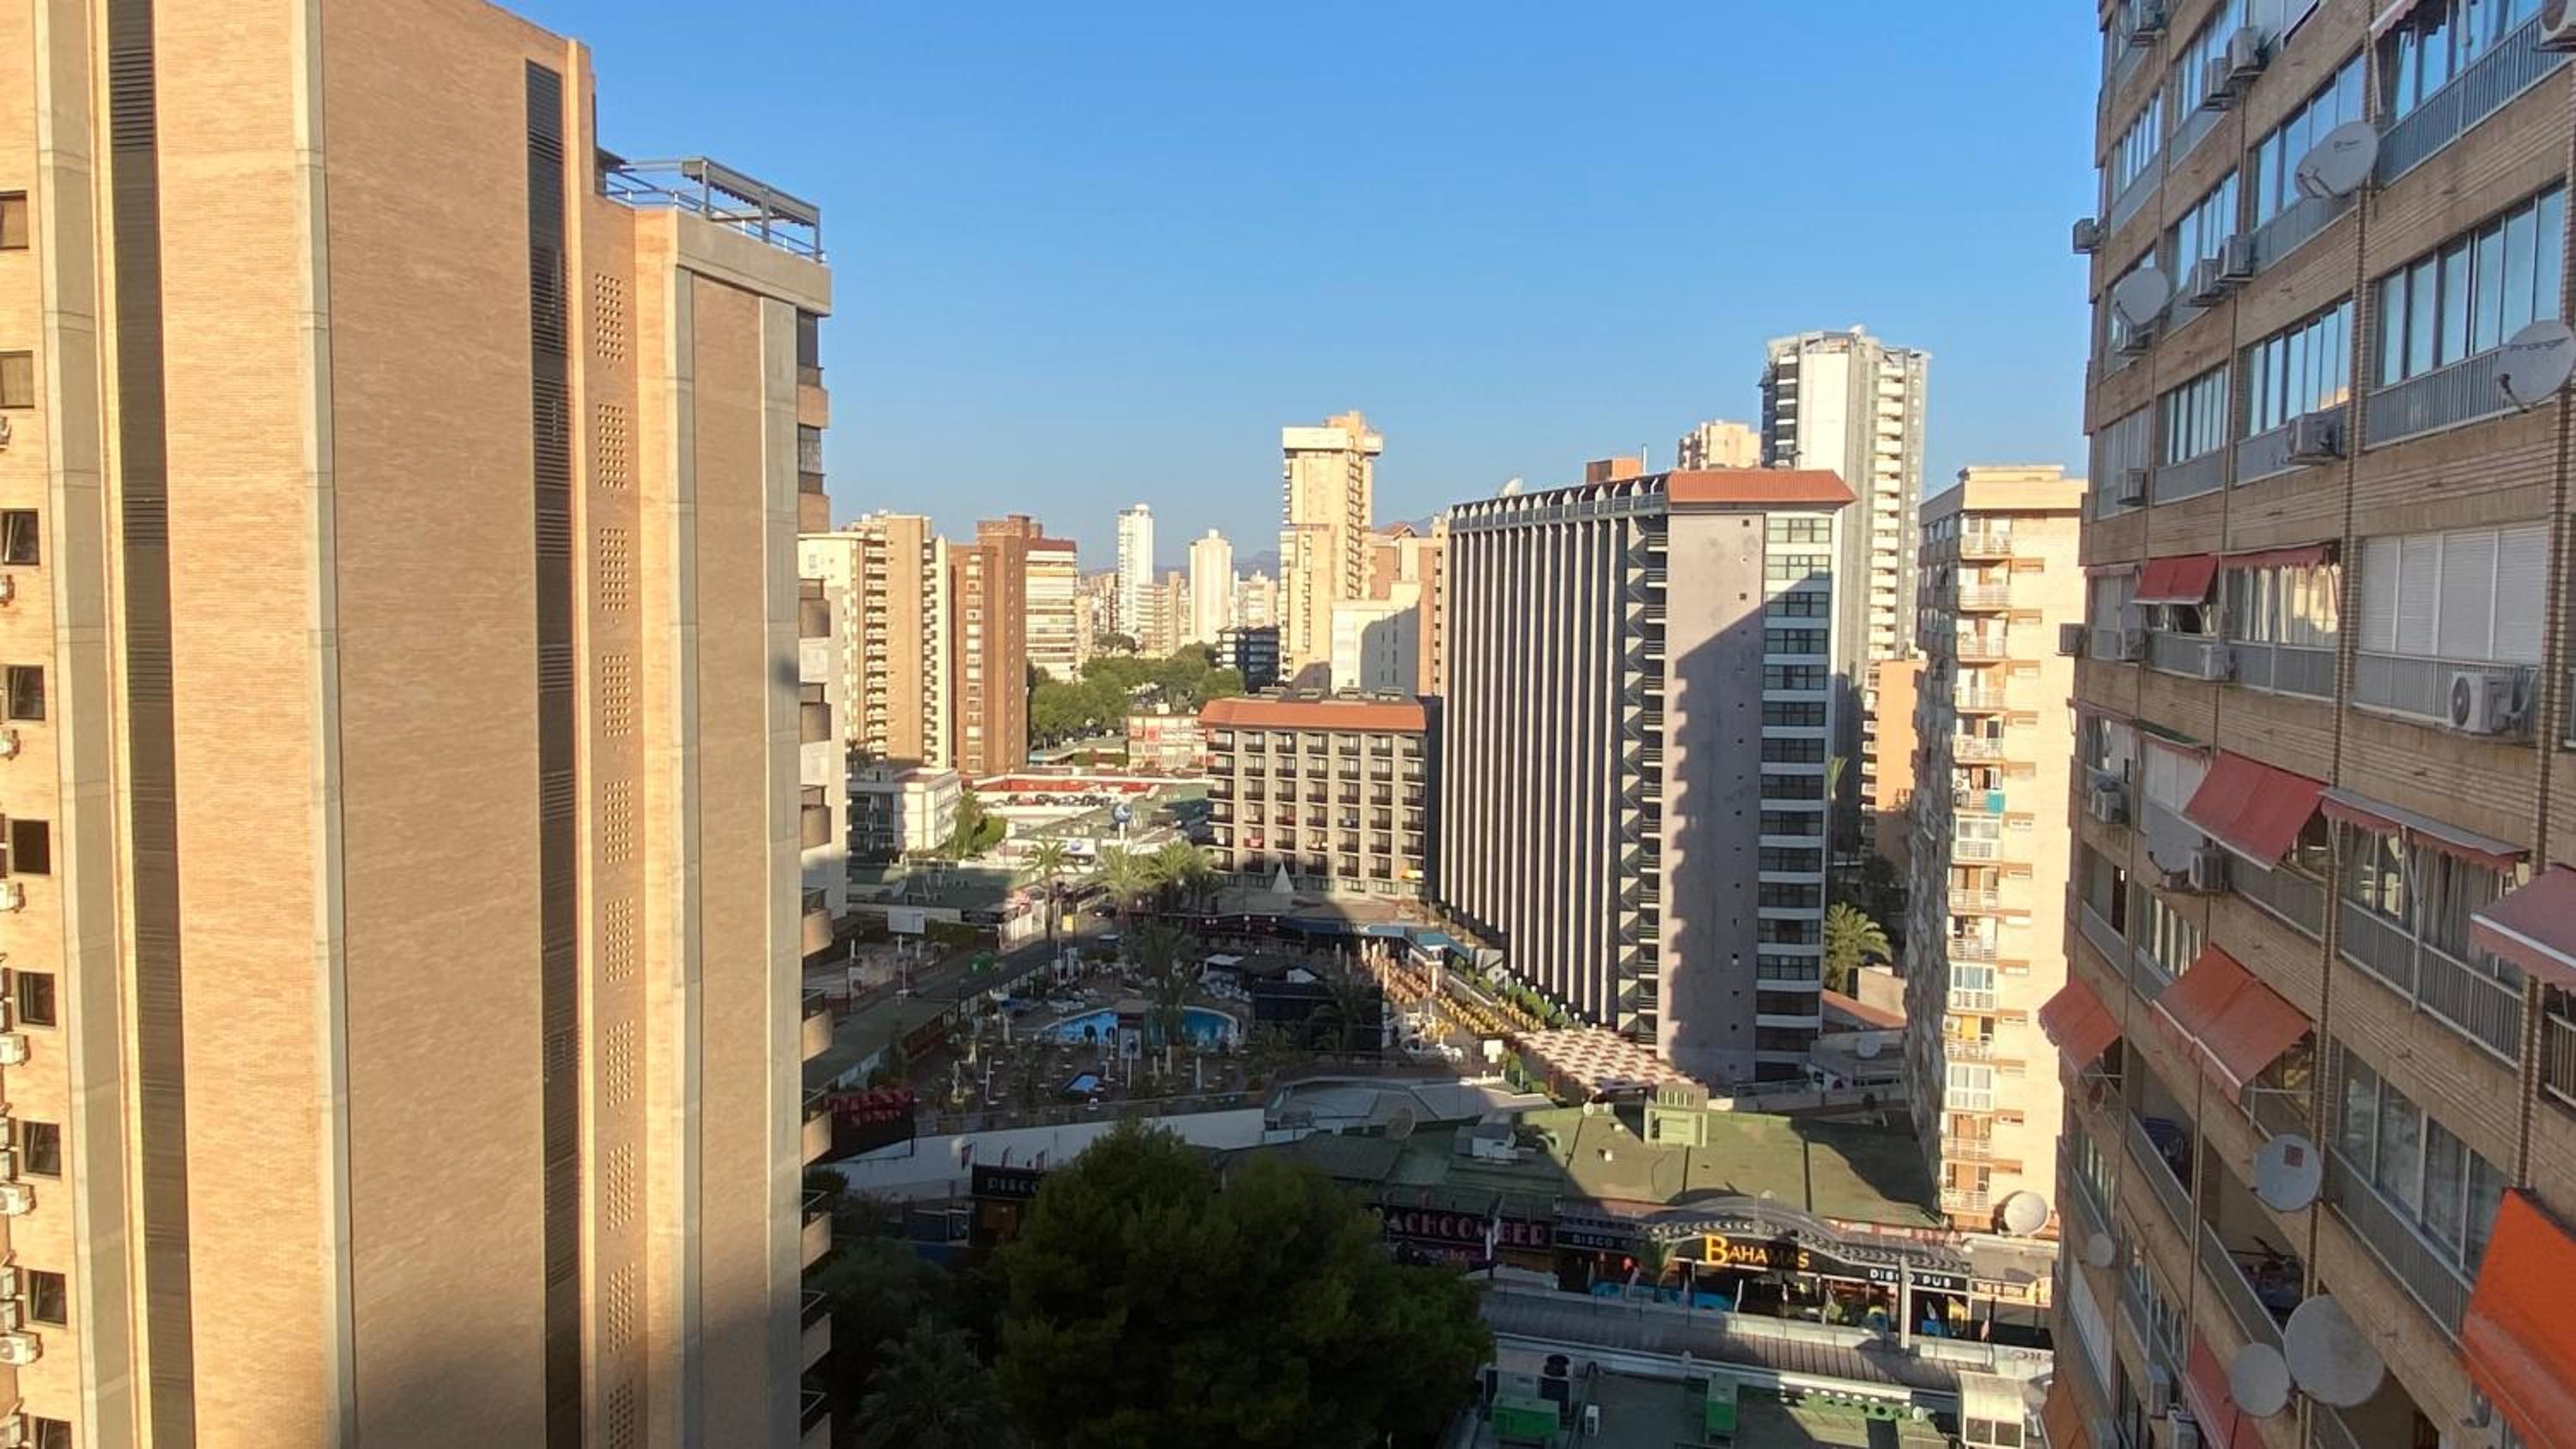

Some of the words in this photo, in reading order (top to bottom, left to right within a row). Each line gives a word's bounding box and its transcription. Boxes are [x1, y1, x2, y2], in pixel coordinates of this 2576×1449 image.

[1387, 1210, 1545, 1246] ACHCOBER
[1704, 1234, 1809, 1269] BAHAMAS
[1923, 1275, 1951, 1288] PUB
